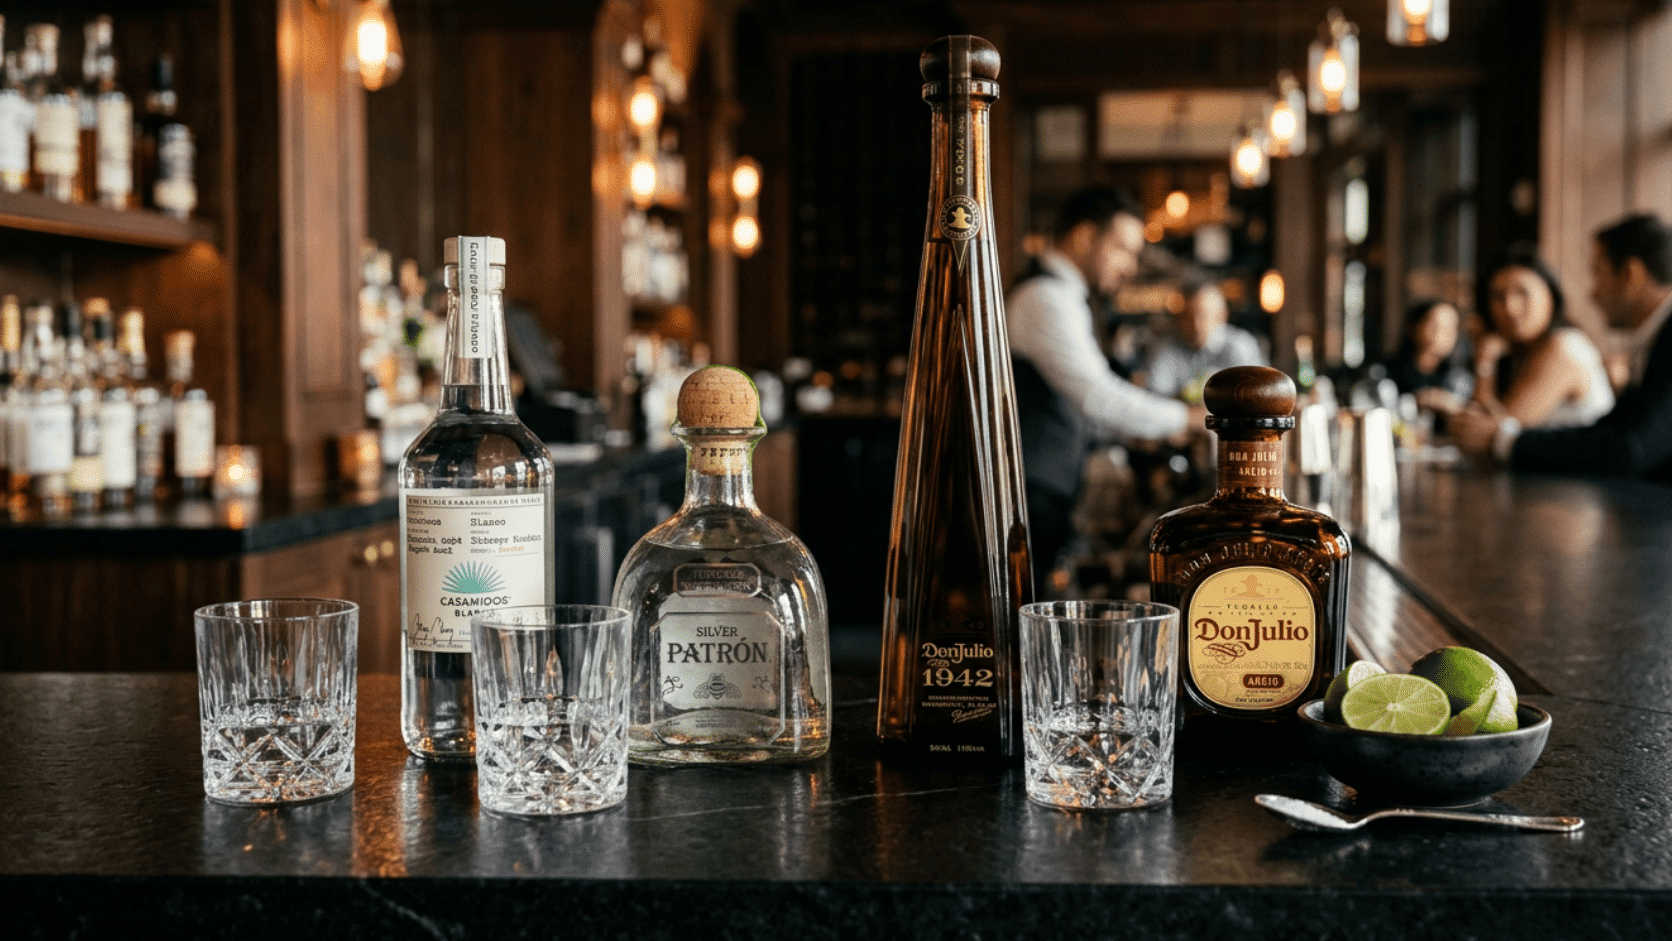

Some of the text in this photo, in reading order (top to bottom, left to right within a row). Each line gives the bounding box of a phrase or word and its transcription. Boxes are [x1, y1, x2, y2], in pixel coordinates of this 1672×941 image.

[696, 626, 739, 637] SILVER
[1194, 617, 1310, 651] DonJulio
[667, 637, 769, 665] PATRÓN
[922, 667, 994, 688] 1942
